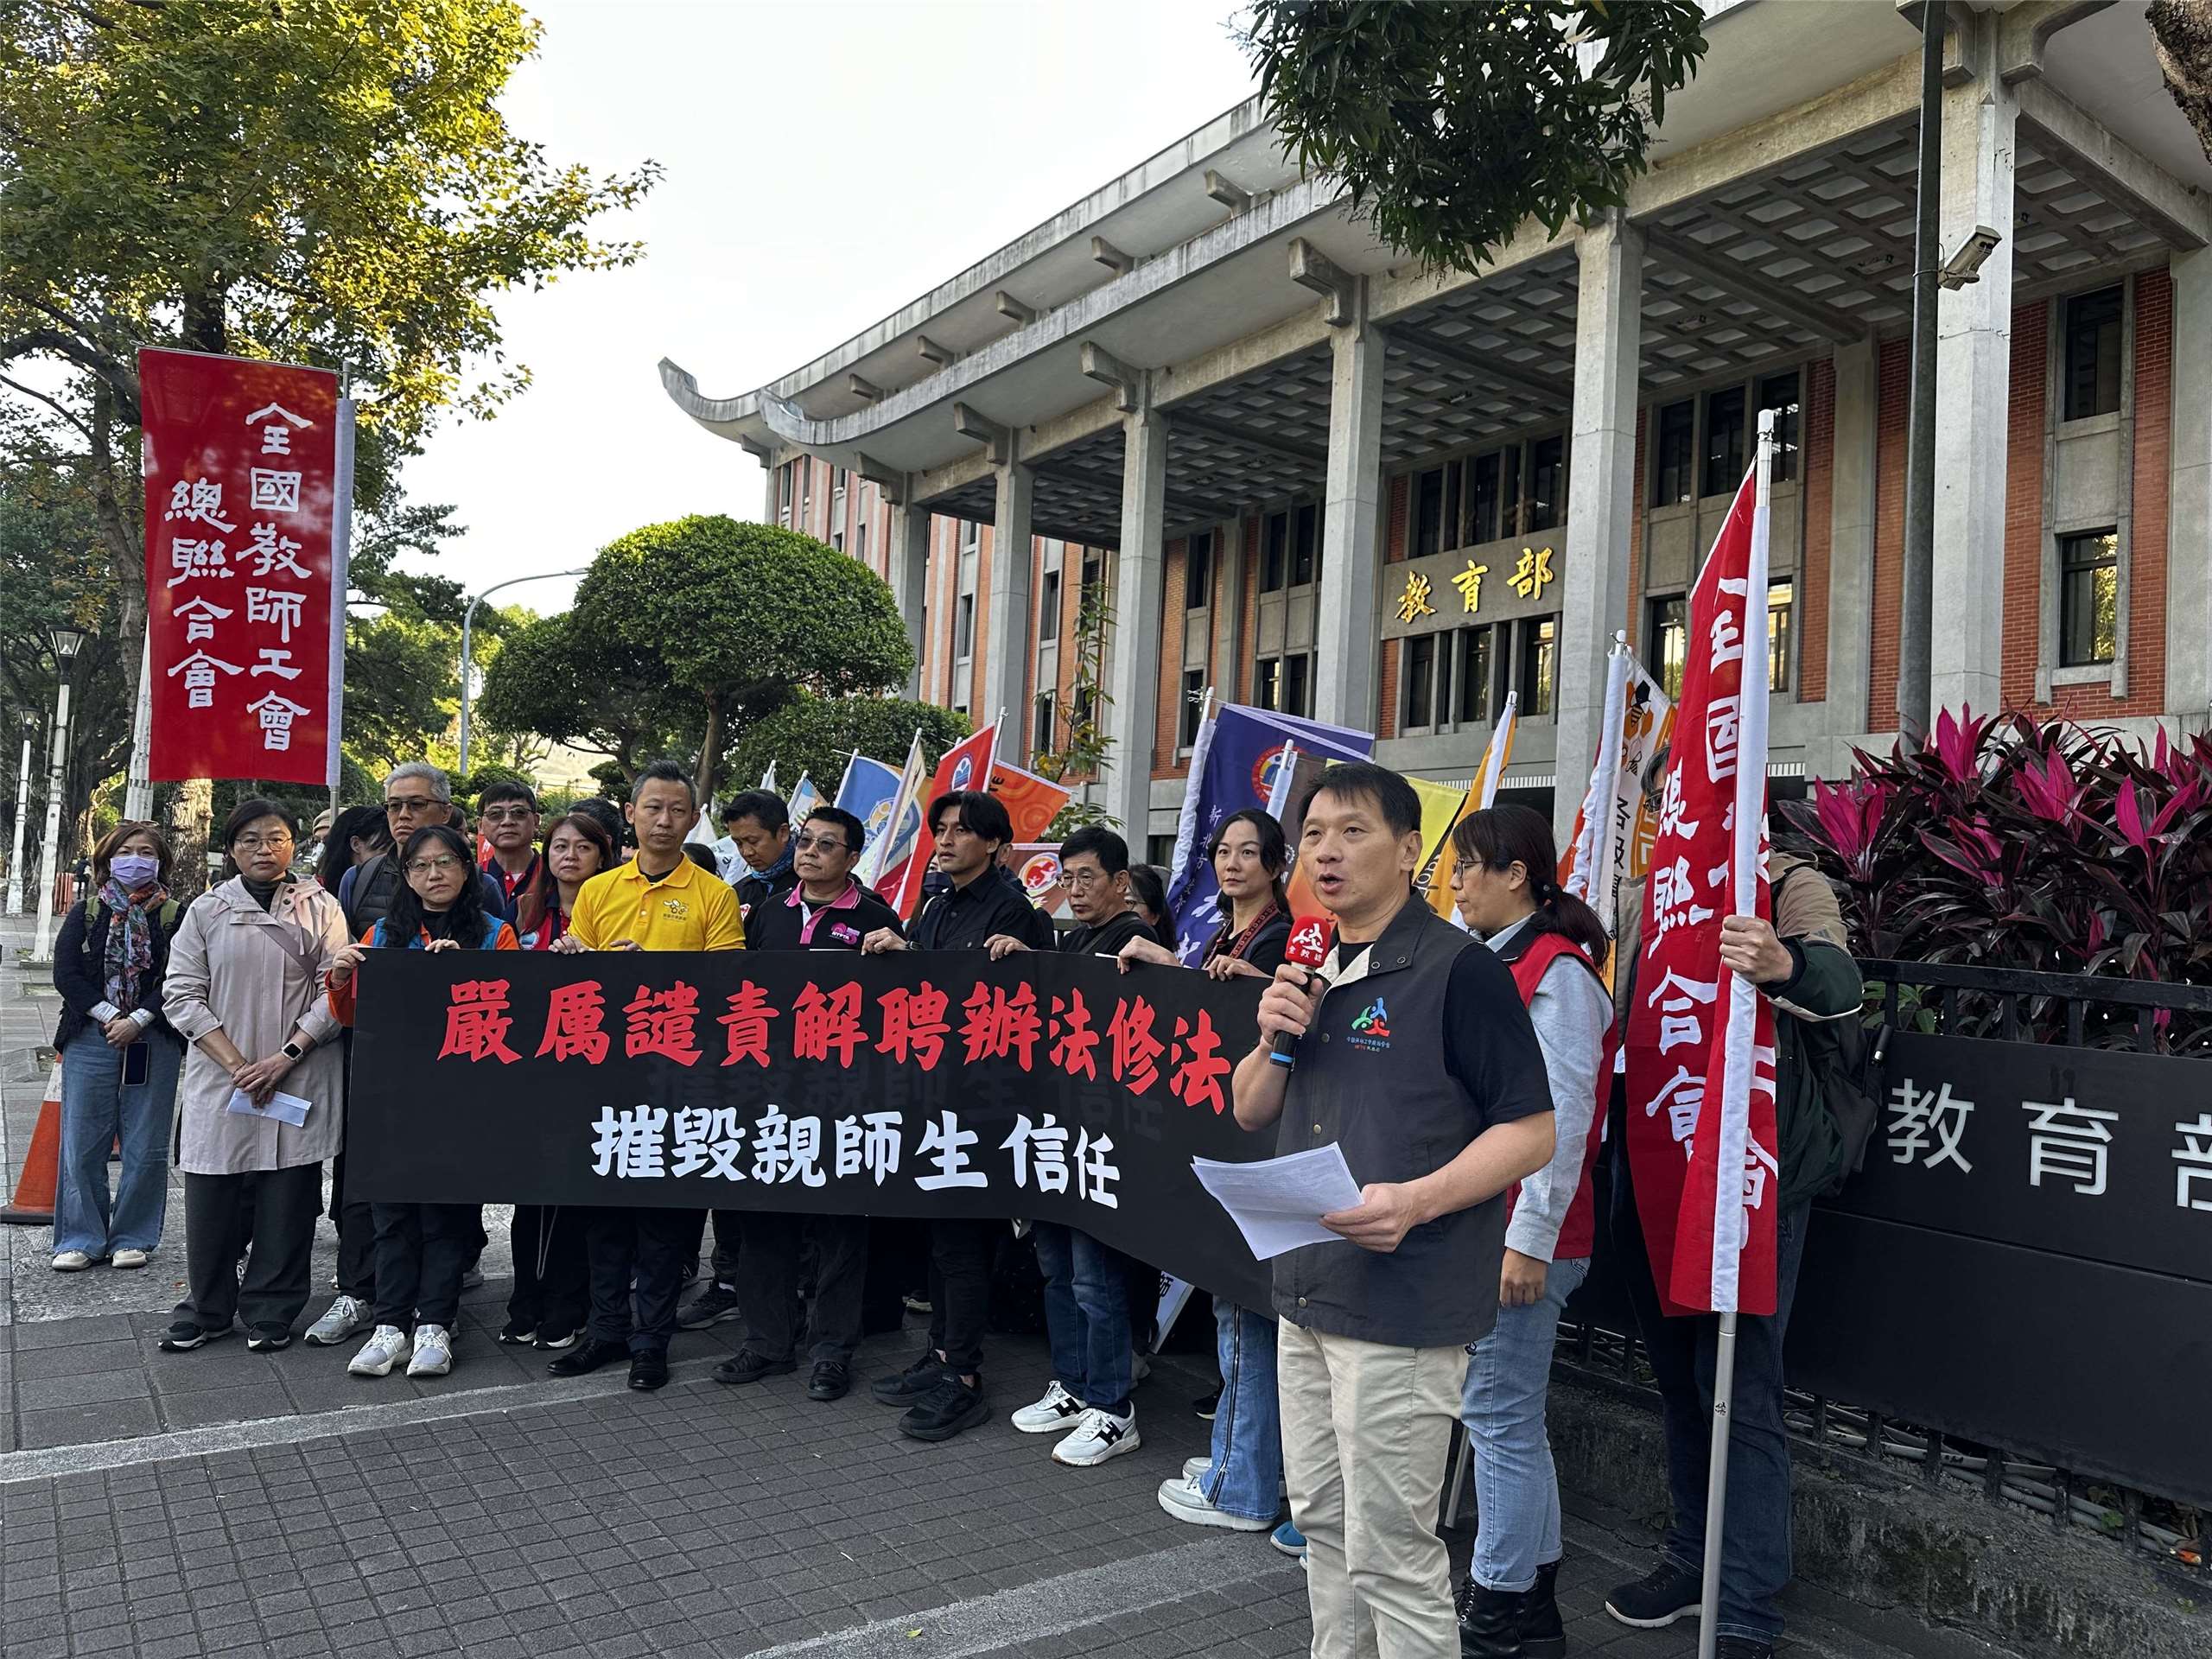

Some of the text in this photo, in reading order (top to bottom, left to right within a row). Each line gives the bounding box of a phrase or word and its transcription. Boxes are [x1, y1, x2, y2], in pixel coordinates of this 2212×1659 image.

[164, 477, 243, 709] 總聯合會
[236, 402, 313, 751] 全國教師工會
[1395, 547, 1554, 624] 教育部
[436, 979, 1232, 1116] 嚴厲譴責解聘辦法修法
[591, 1104, 1121, 1210] 摧毀親師生信任
